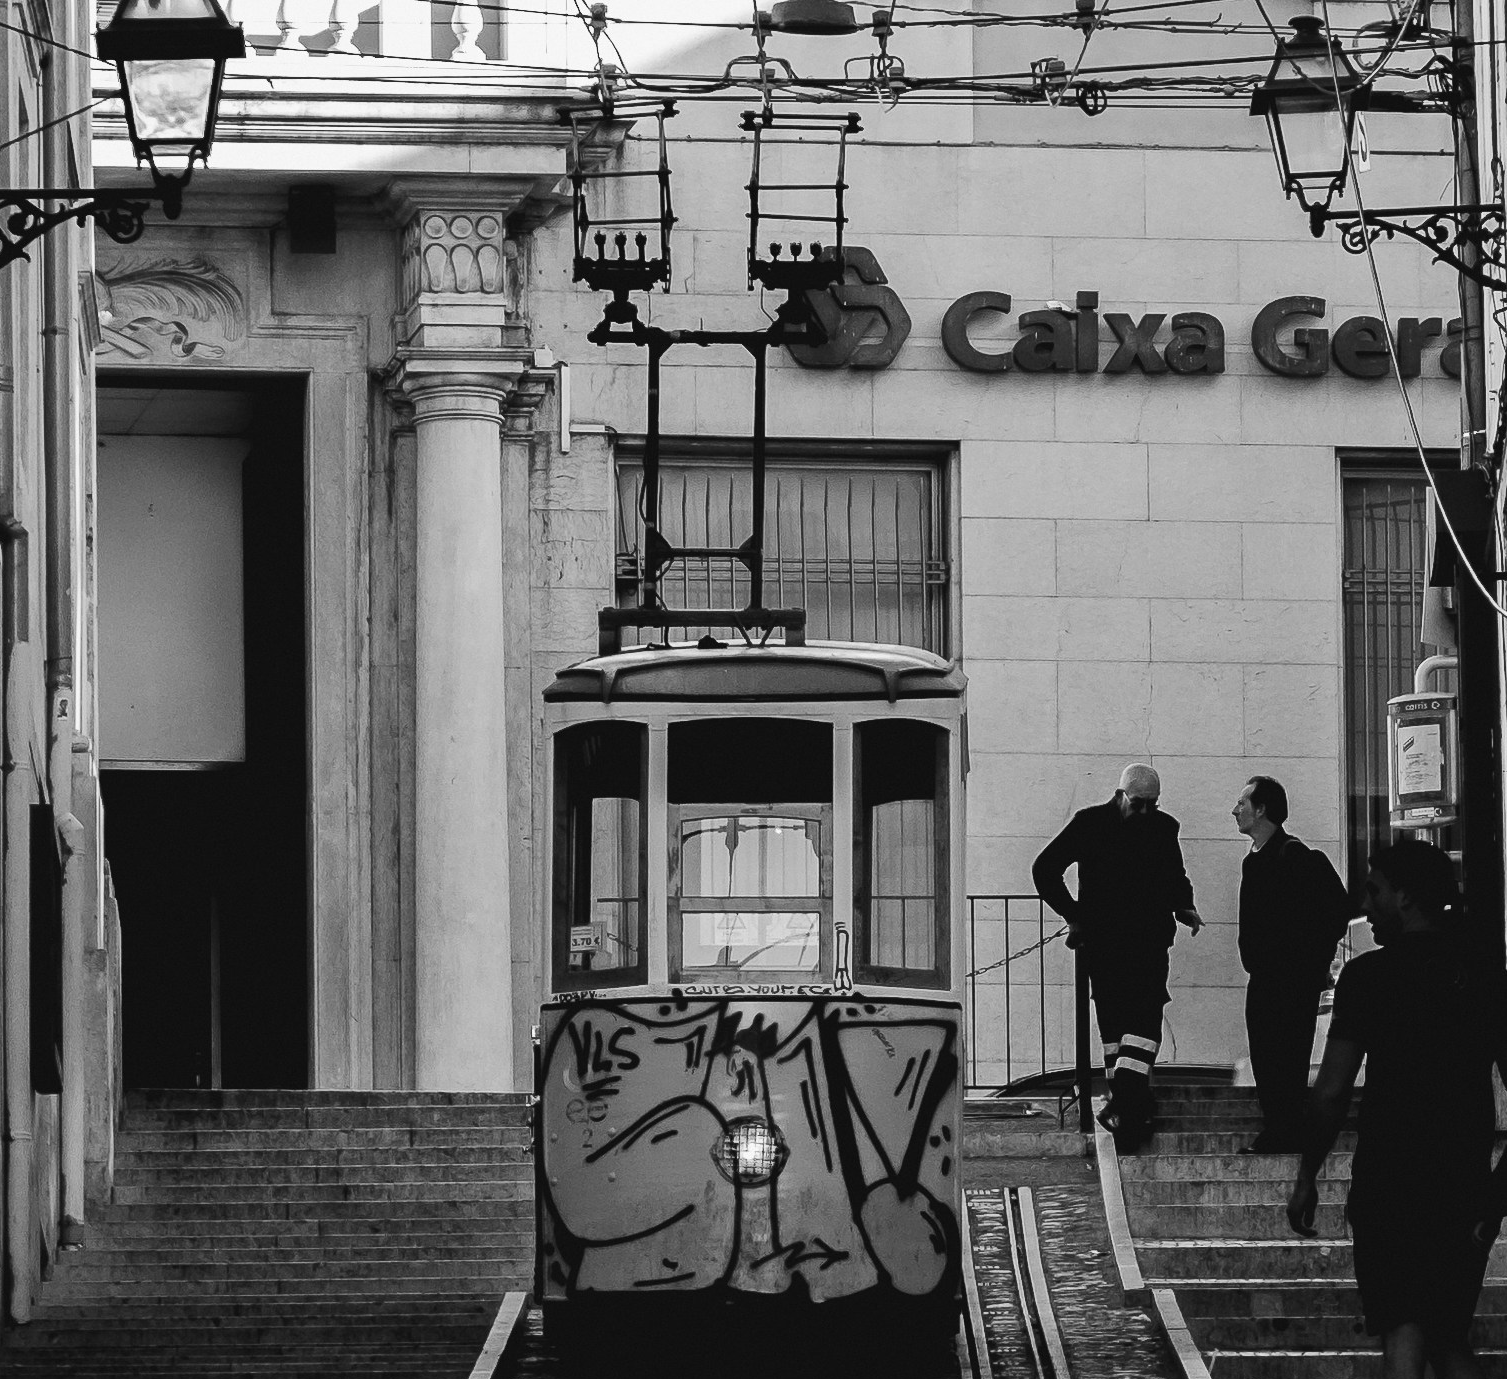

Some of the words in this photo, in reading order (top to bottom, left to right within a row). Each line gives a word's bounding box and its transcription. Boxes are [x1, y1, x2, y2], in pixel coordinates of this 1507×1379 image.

[940, 290, 1226, 375] Caixa
[1404, 701, 1428, 712] carris
[571, 937, 592, 947] 3.70
